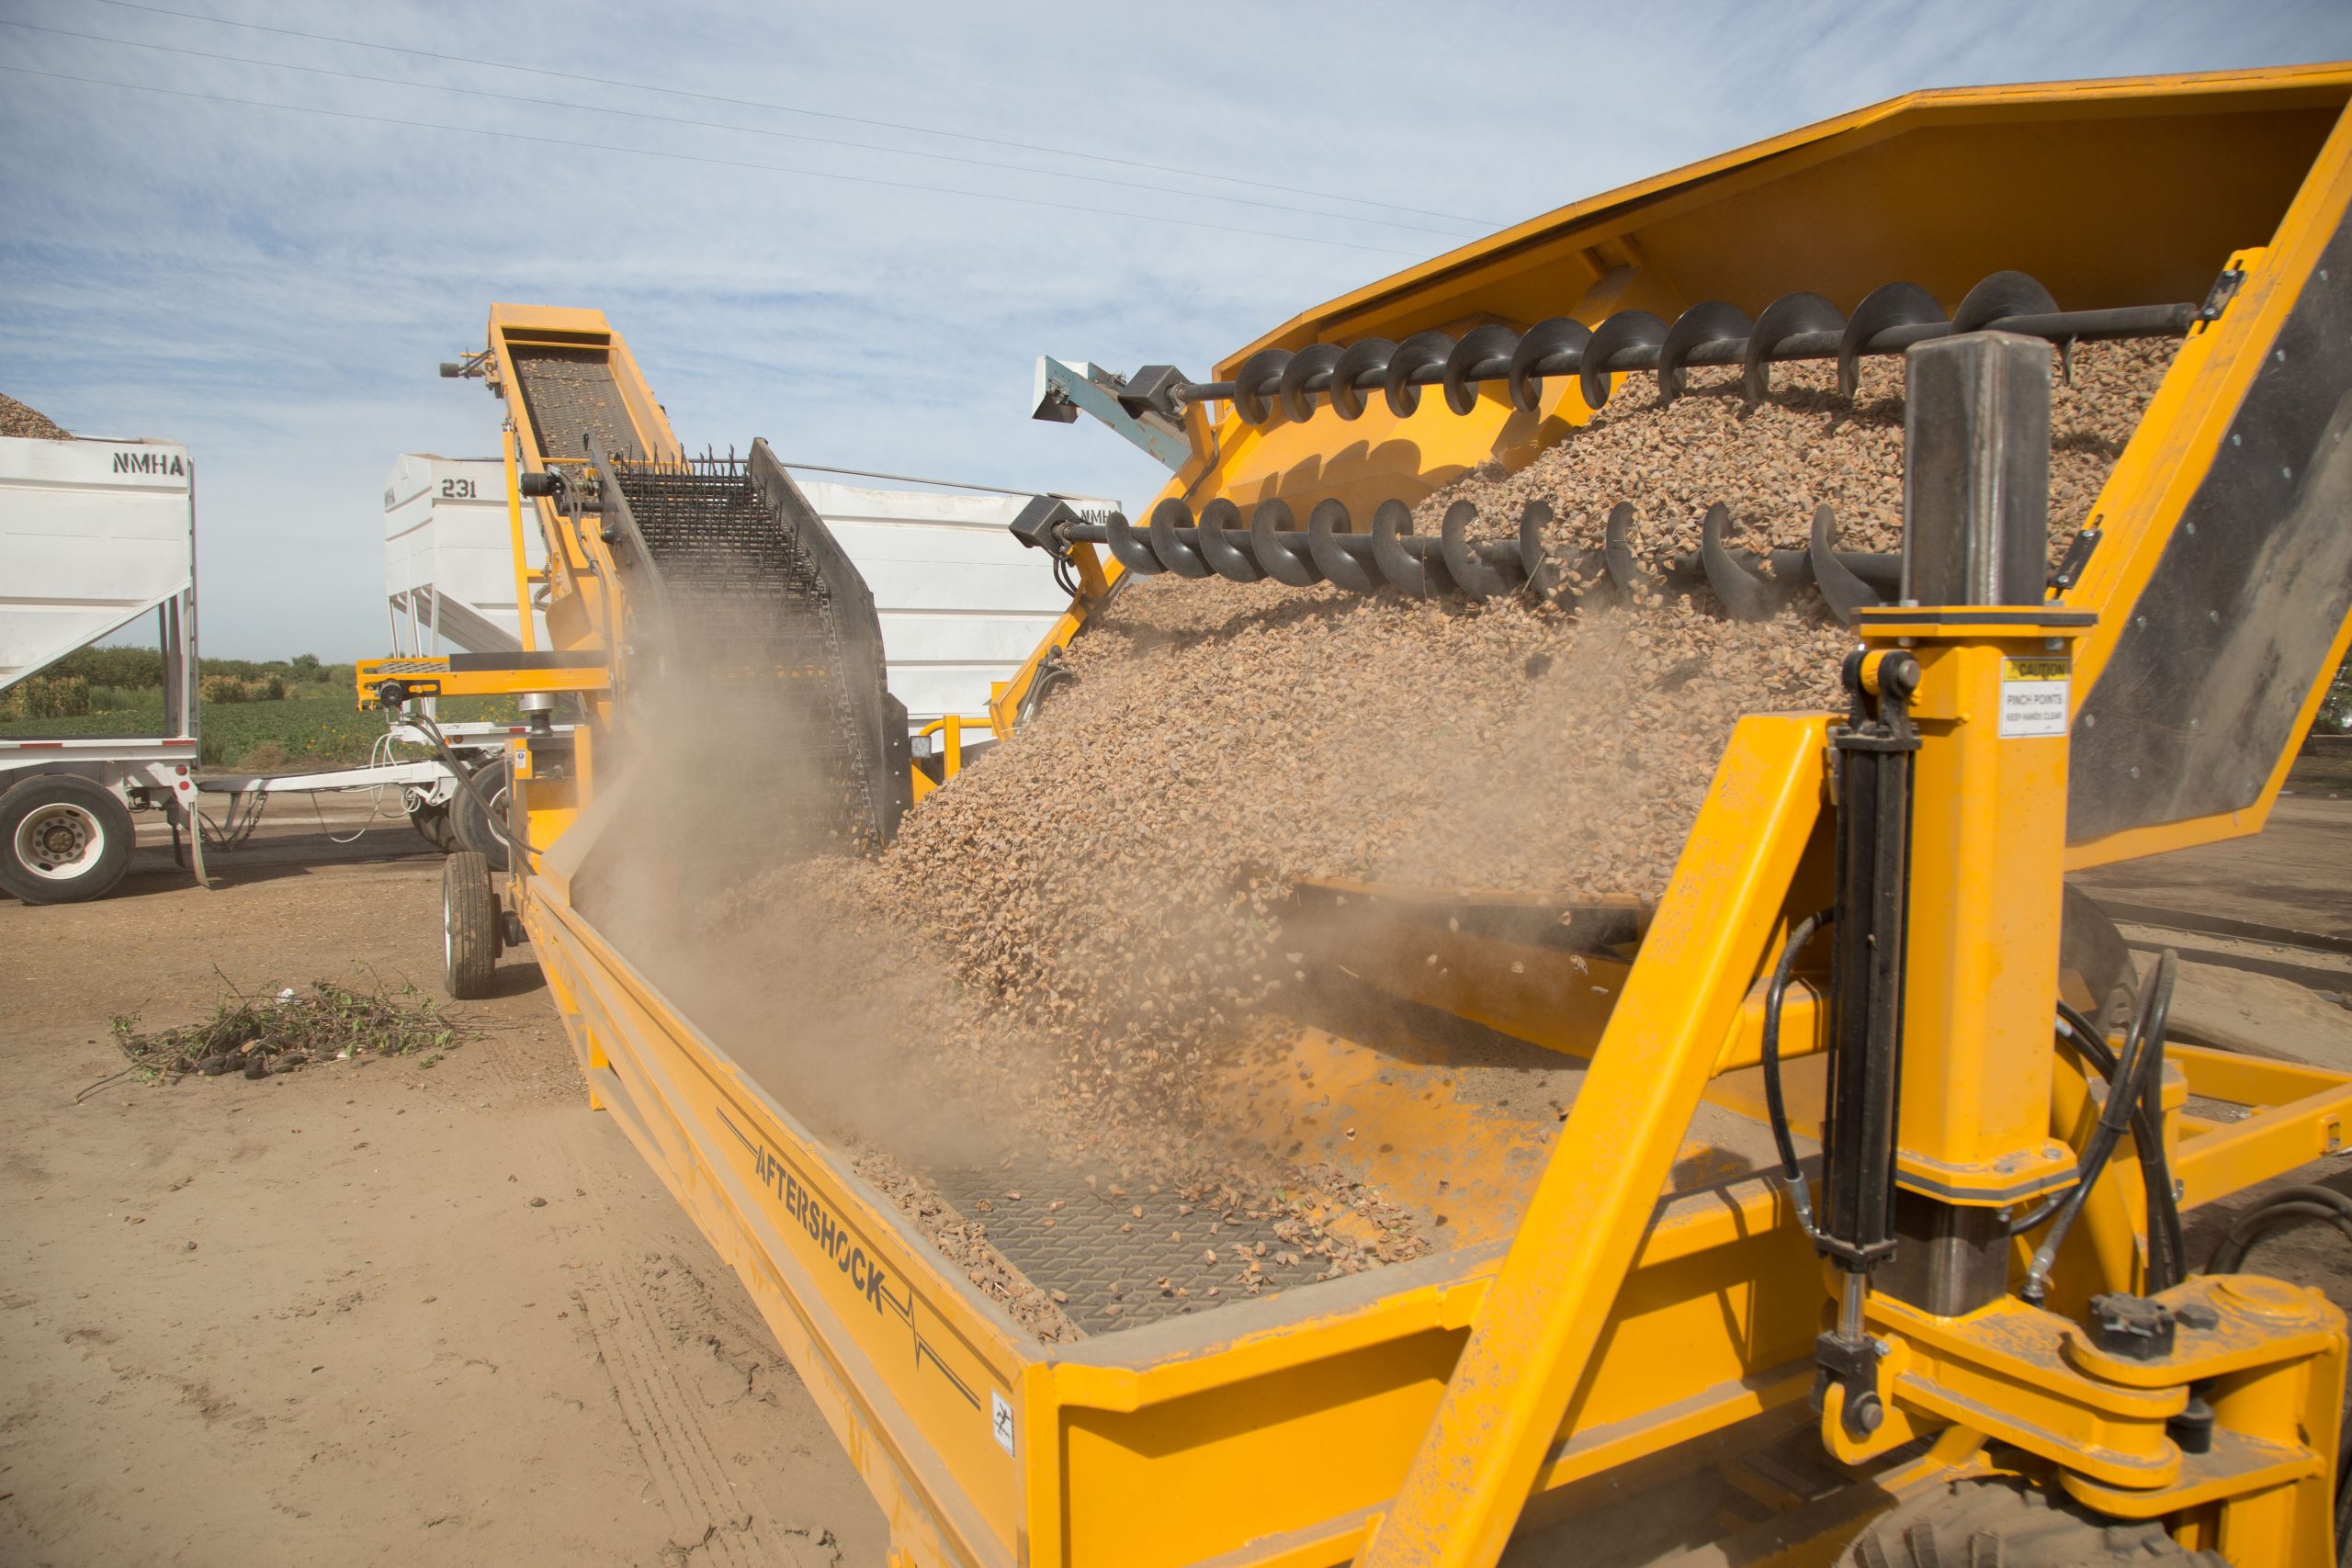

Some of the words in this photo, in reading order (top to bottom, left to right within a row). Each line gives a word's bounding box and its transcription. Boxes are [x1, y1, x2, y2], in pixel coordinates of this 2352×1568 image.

[113, 452, 185, 476] NMHA
[442, 479, 476, 498] 231
[1080, 509, 1117, 525] NMH
[2019, 663, 2066, 676] CAUTION
[2007, 694, 2031, 705] PINCH
[2034, 694, 2063, 705] POINTS
[755, 1145, 886, 1315] AFTERSHOCK
